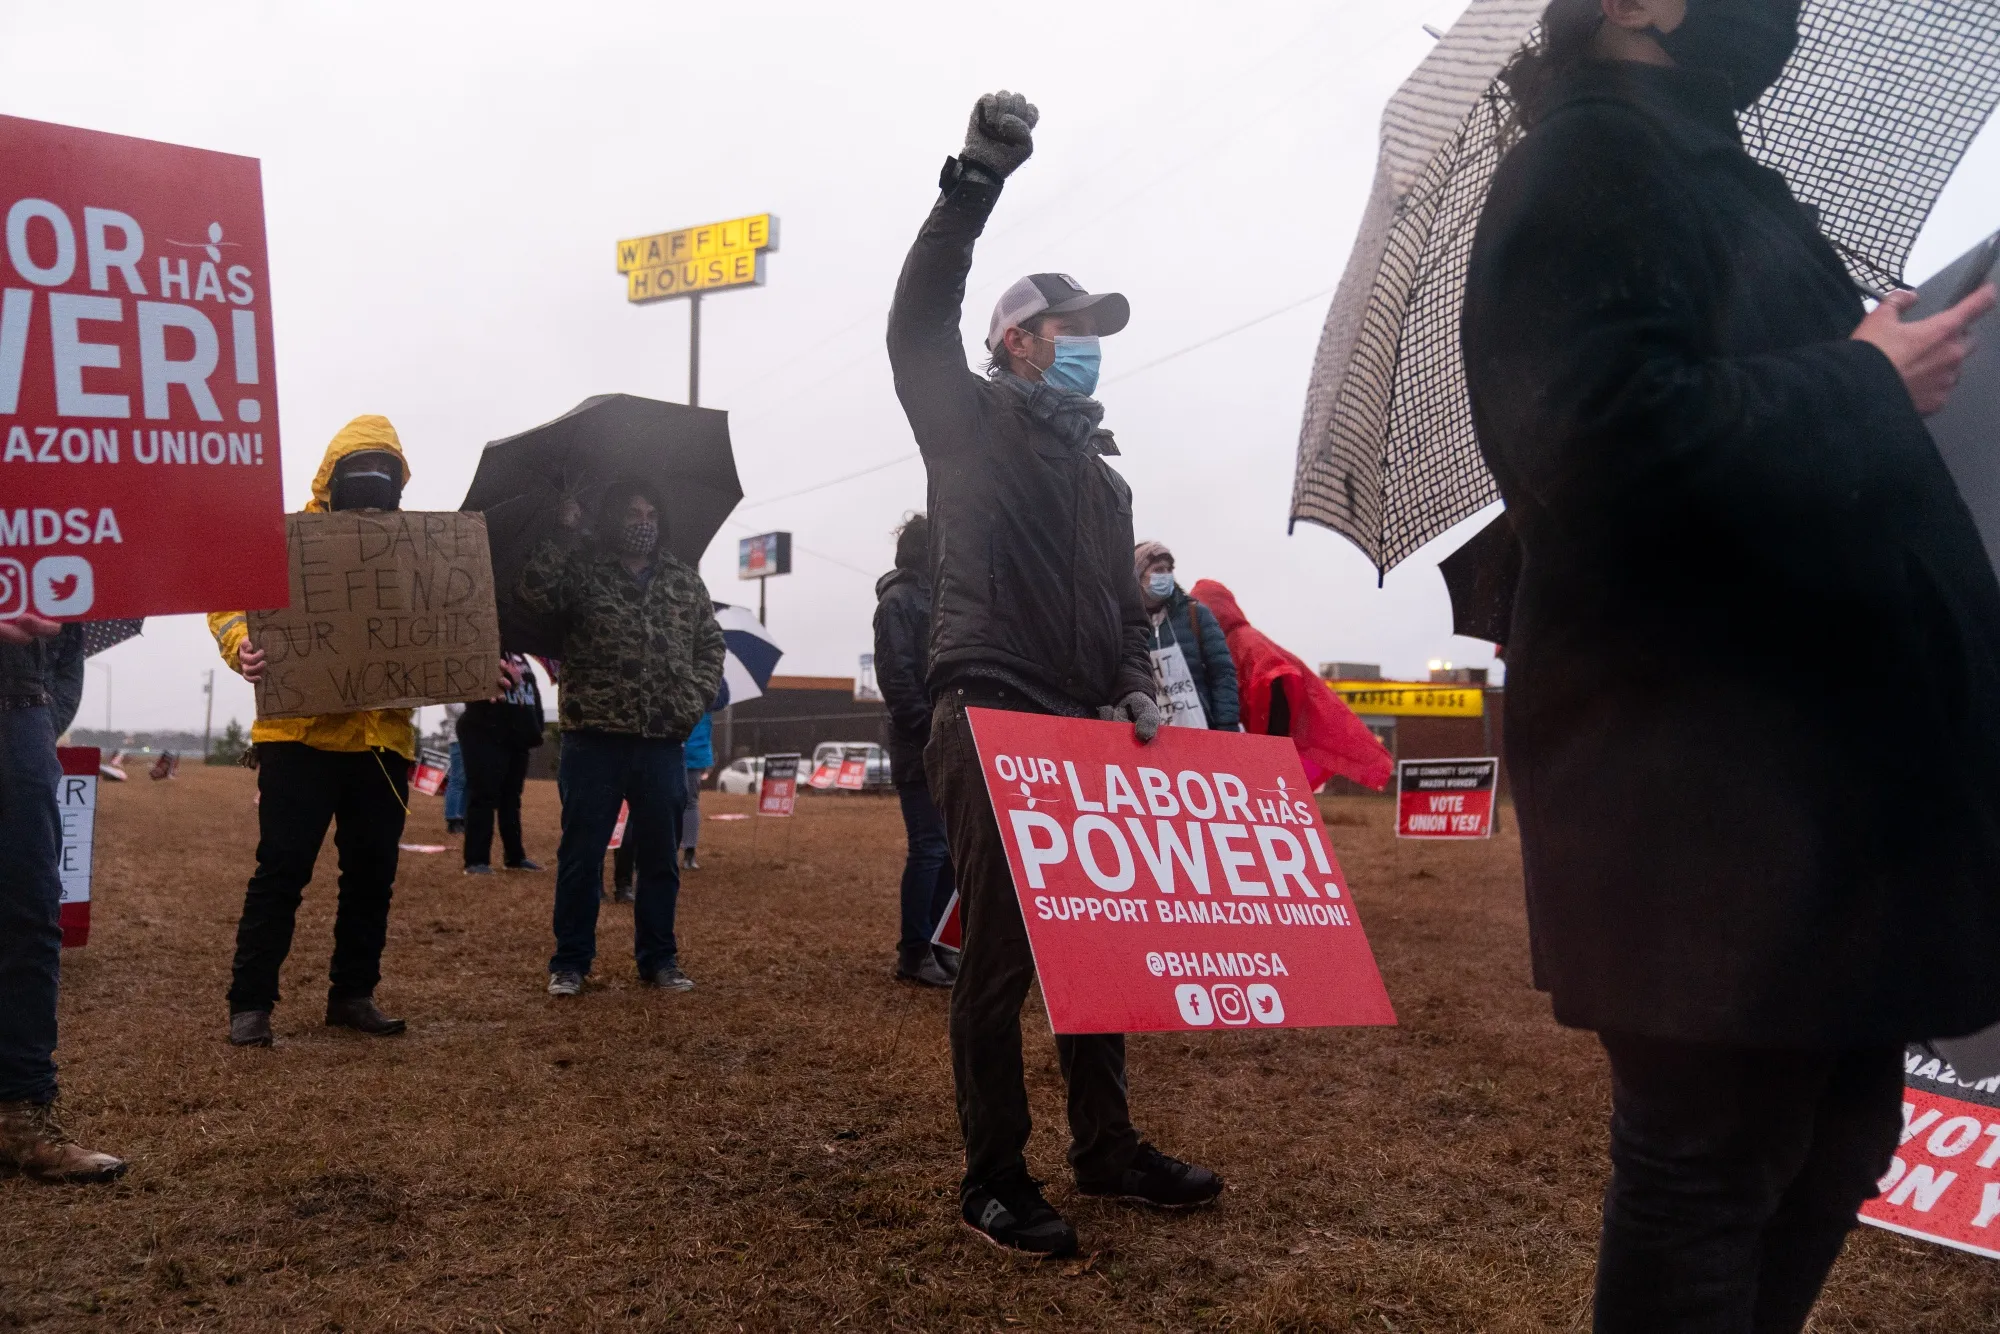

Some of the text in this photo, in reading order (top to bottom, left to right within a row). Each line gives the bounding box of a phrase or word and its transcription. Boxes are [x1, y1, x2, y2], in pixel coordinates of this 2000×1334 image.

[6, 198, 255, 305] OR HAS
[621, 220, 763, 265] WAFFLE
[633, 256, 749, 295] HOUSE
[3, 426, 264, 466] AZON UNION!
[0, 507, 123, 546] MDSA
[357, 515, 479, 563] DARE
[257, 567, 476, 619] EFEND
[257, 611, 483, 664] OUR RIGHTS
[262, 666, 307, 710] AS
[327, 654, 490, 708] WORKERS!
[1414, 692, 1466, 707] HOUSE
[994, 754, 1314, 826] OUR LABOR HAS
[1429, 795, 1465, 813] VOTE
[1408, 813, 1482, 832] UNION YES!
[1009, 808, 1341, 899] POWER!
[1034, 895, 1352, 927] SUPPORT BAMAZON UNION!
[1145, 951, 1290, 978] @BHAMDSA
